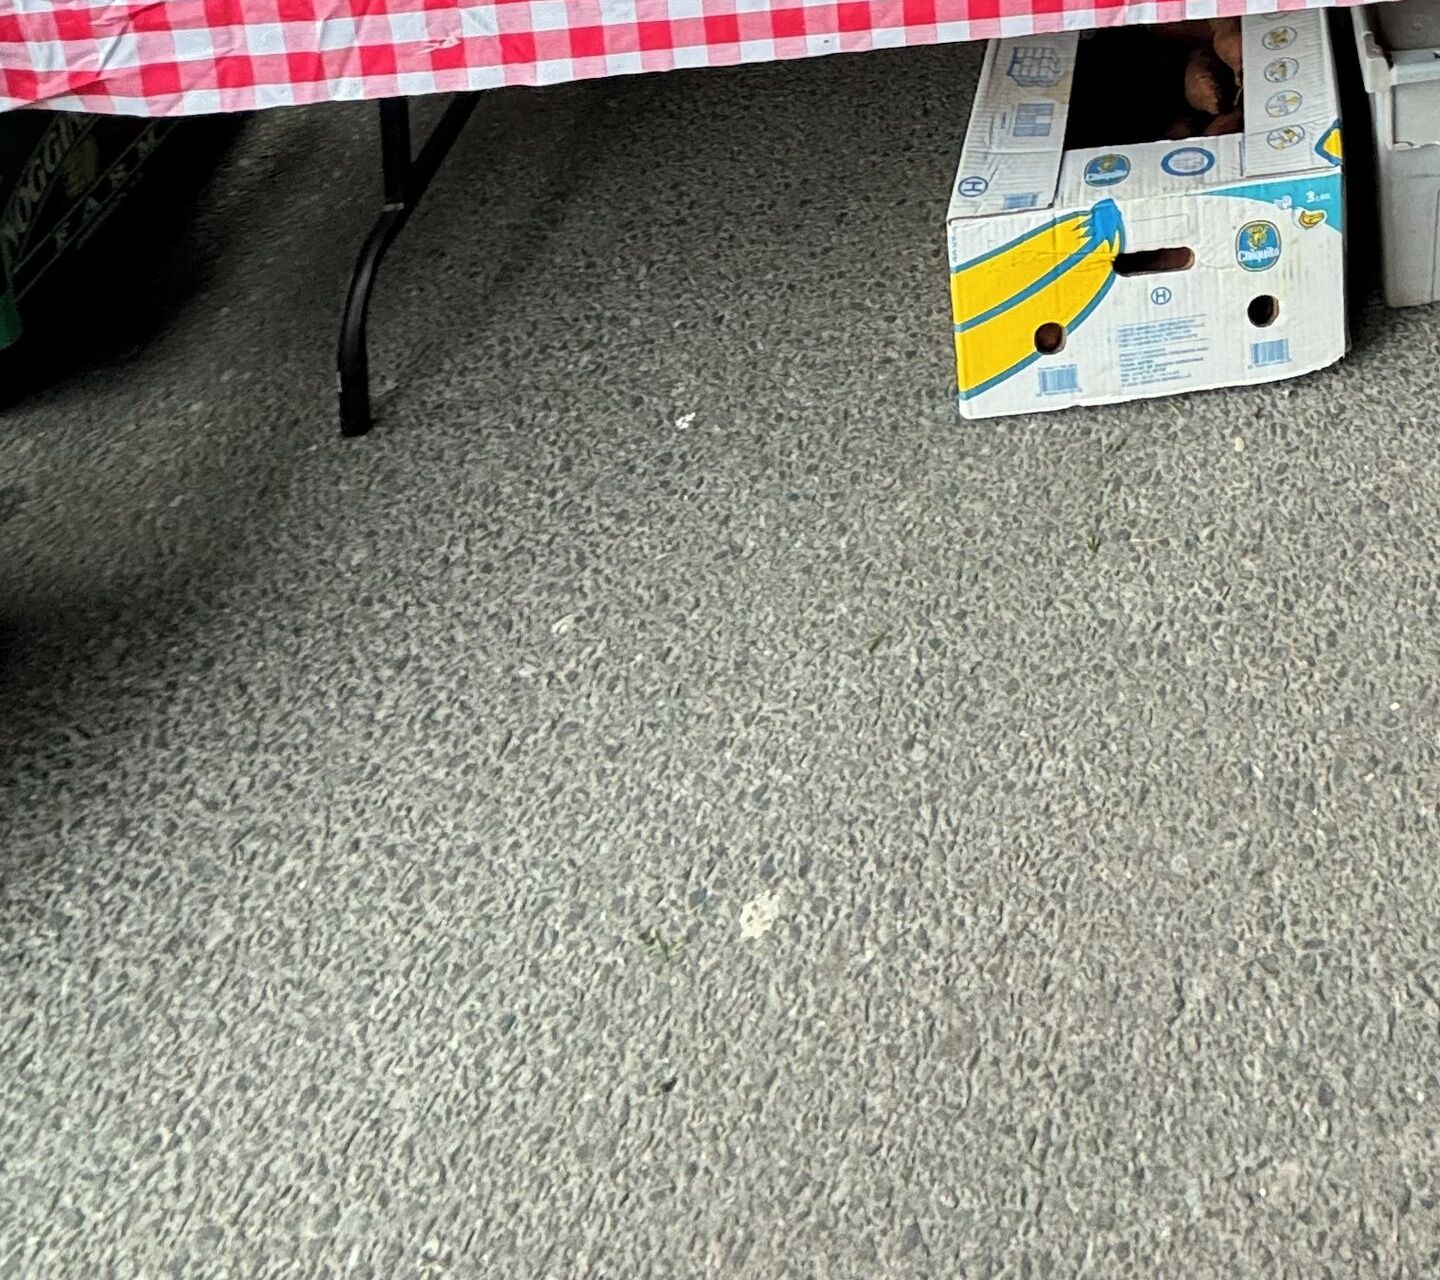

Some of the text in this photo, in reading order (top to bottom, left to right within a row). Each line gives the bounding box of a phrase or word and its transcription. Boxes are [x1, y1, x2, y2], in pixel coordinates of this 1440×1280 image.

[1305, 190, 1315, 203] 3
[1237, 246, 1279, 262] Chiquita
[1155, 290, 1168, 303] H
